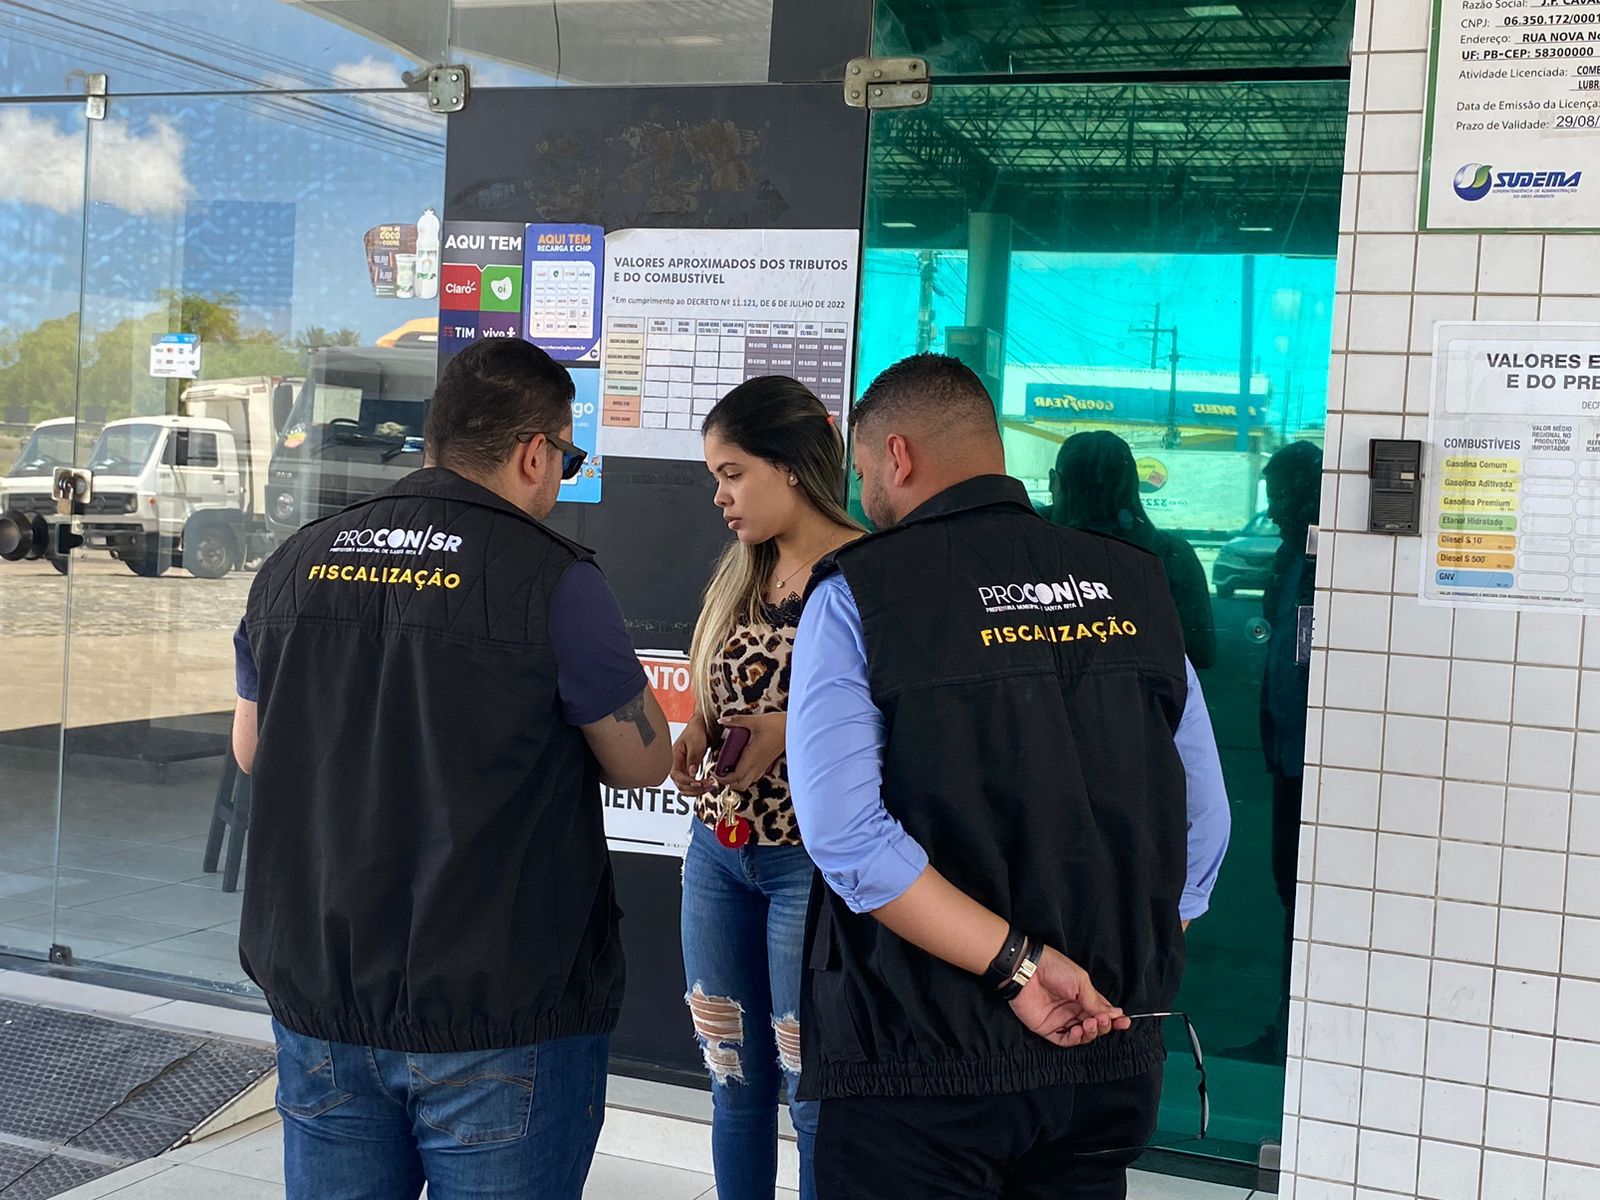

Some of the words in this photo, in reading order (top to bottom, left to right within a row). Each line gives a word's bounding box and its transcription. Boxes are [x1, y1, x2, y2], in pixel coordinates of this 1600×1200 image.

[1461, 18, 1490, 28] CNPJ:
[1460, 35, 1511, 46] Endereço:
[1522, 33, 1547, 43] RUA
[1550, 32, 1585, 42] NOVA
[1462, 50, 1480, 60] UF:
[1535, 47, 1594, 58] 58300000
[1459, 69, 1508, 80] Atividade
[1510, 68, 1568, 78] Licenciada:
[1457, 102, 1480, 111] Data
[1483, 101, 1496, 111] de
[1499, 100, 1541, 110] Emissão
[1543, 100, 1556, 109] da
[1456, 121, 1484, 131] Prazo
[1487, 120, 1500, 130] de
[1502, 119, 1549, 130] Validade:
[1493, 171, 1582, 187] SUDEMA
[445, 234, 485, 250] AQUI
[489, 236, 523, 251] TEM
[538, 234, 566, 245] AQUI
[568, 234, 592, 245] TEM
[614, 256, 665, 268] VALORES
[668, 258, 756, 270] APROXIMADOS
[760, 259, 785, 270] DOS
[789, 259, 848, 271] TRIBUTOS
[614, 272, 620, 282] E
[624, 273, 641, 282] DO
[645, 271, 725, 284] COMBUSTÍVEL
[445, 282, 472, 294] Claro
[628, 297, 674, 306] cumprimento
[687, 298, 719, 306] DECRETO
[789, 300, 813, 308] JULHO
[455, 327, 475, 339] TIM
[1486, 353, 1581, 369] VALORES
[1506, 374, 1519, 389] E
[1526, 374, 1556, 389] DO
[1563, 375, 1600, 390] PRE
[1444, 437, 1521, 450] COMBUSTÍVEIS
[1446, 460, 1477, 468] Gasolina
[1444, 479, 1476, 487] Gasolina
[1443, 497, 1475, 506] Gasolina
[1442, 516, 1465, 525] Etanol
[1467, 516, 1504, 526] Hidratado
[1441, 535, 1464, 544] Diesel
[1440, 554, 1463, 562] Diesel
[308, 564, 461, 591] FISCALIZAÇÃO
[1439, 572, 1455, 580] GNV
